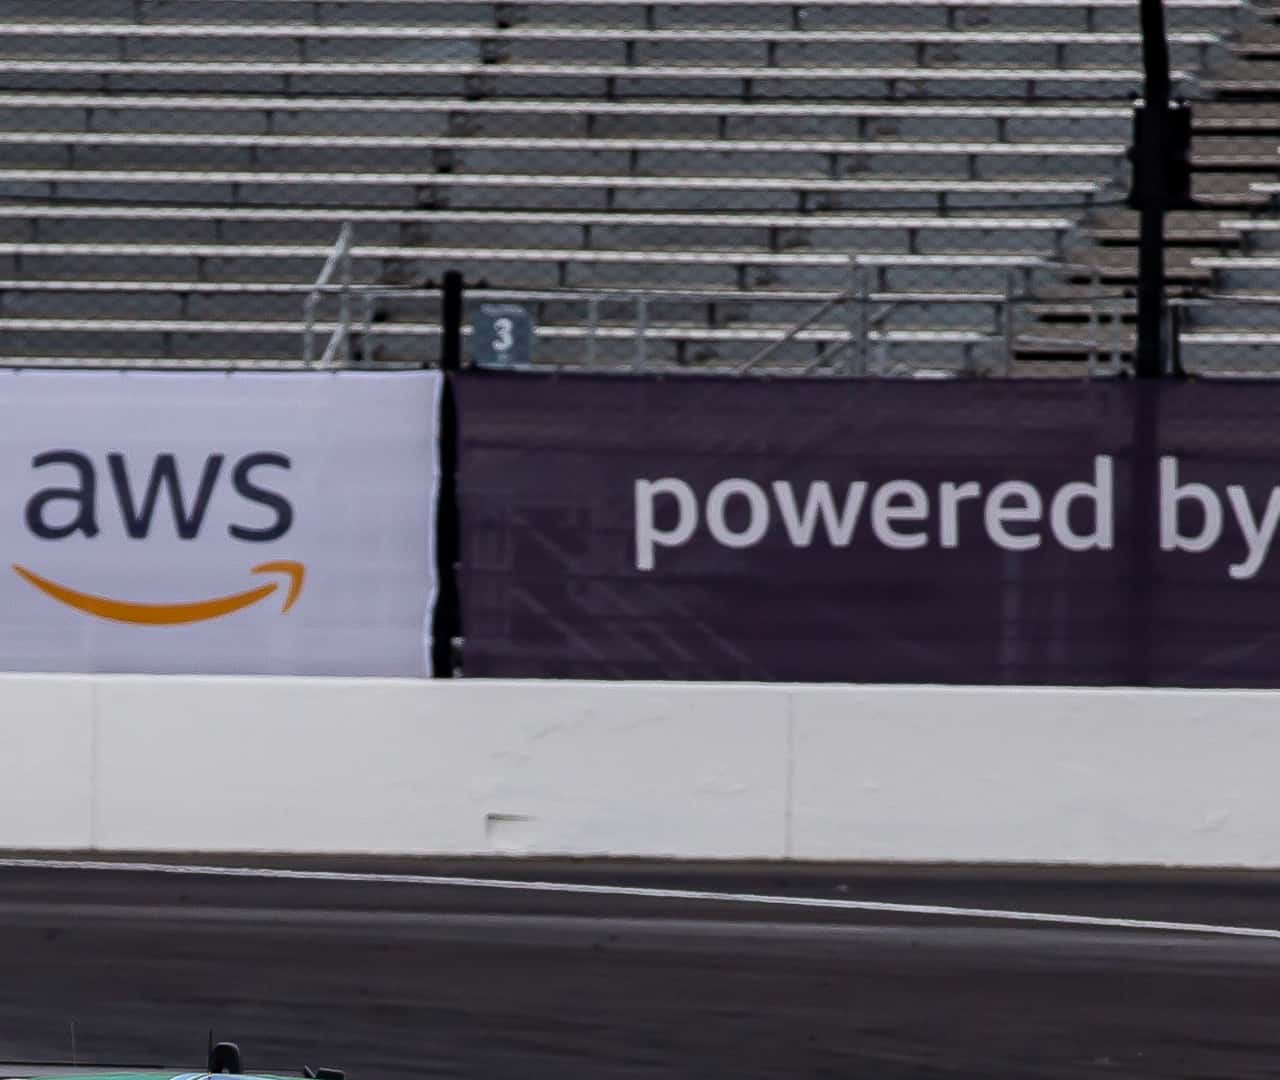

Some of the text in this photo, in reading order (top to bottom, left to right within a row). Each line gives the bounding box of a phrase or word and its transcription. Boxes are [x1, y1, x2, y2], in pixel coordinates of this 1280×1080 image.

[491, 317, 514, 351] 3
[23, 448, 296, 544] aws
[634, 454, 1113, 571] powered
